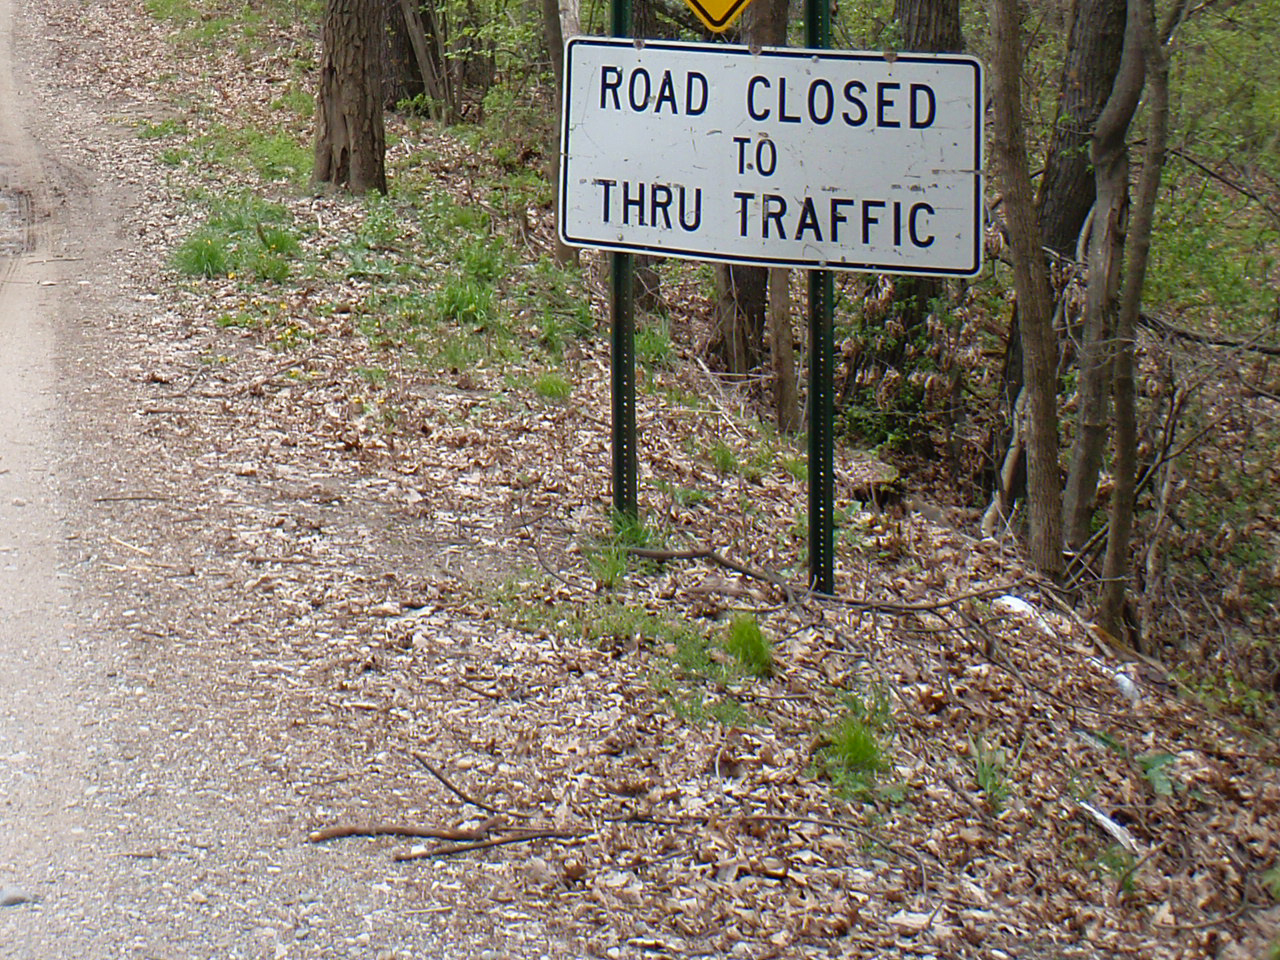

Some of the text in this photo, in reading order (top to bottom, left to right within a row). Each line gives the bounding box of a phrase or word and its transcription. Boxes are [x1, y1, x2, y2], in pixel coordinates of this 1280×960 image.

[599, 65, 937, 130] ROAD CLOSED
[732, 136, 778, 177] TO
[596, 178, 936, 249] THRU TRAFFIC
